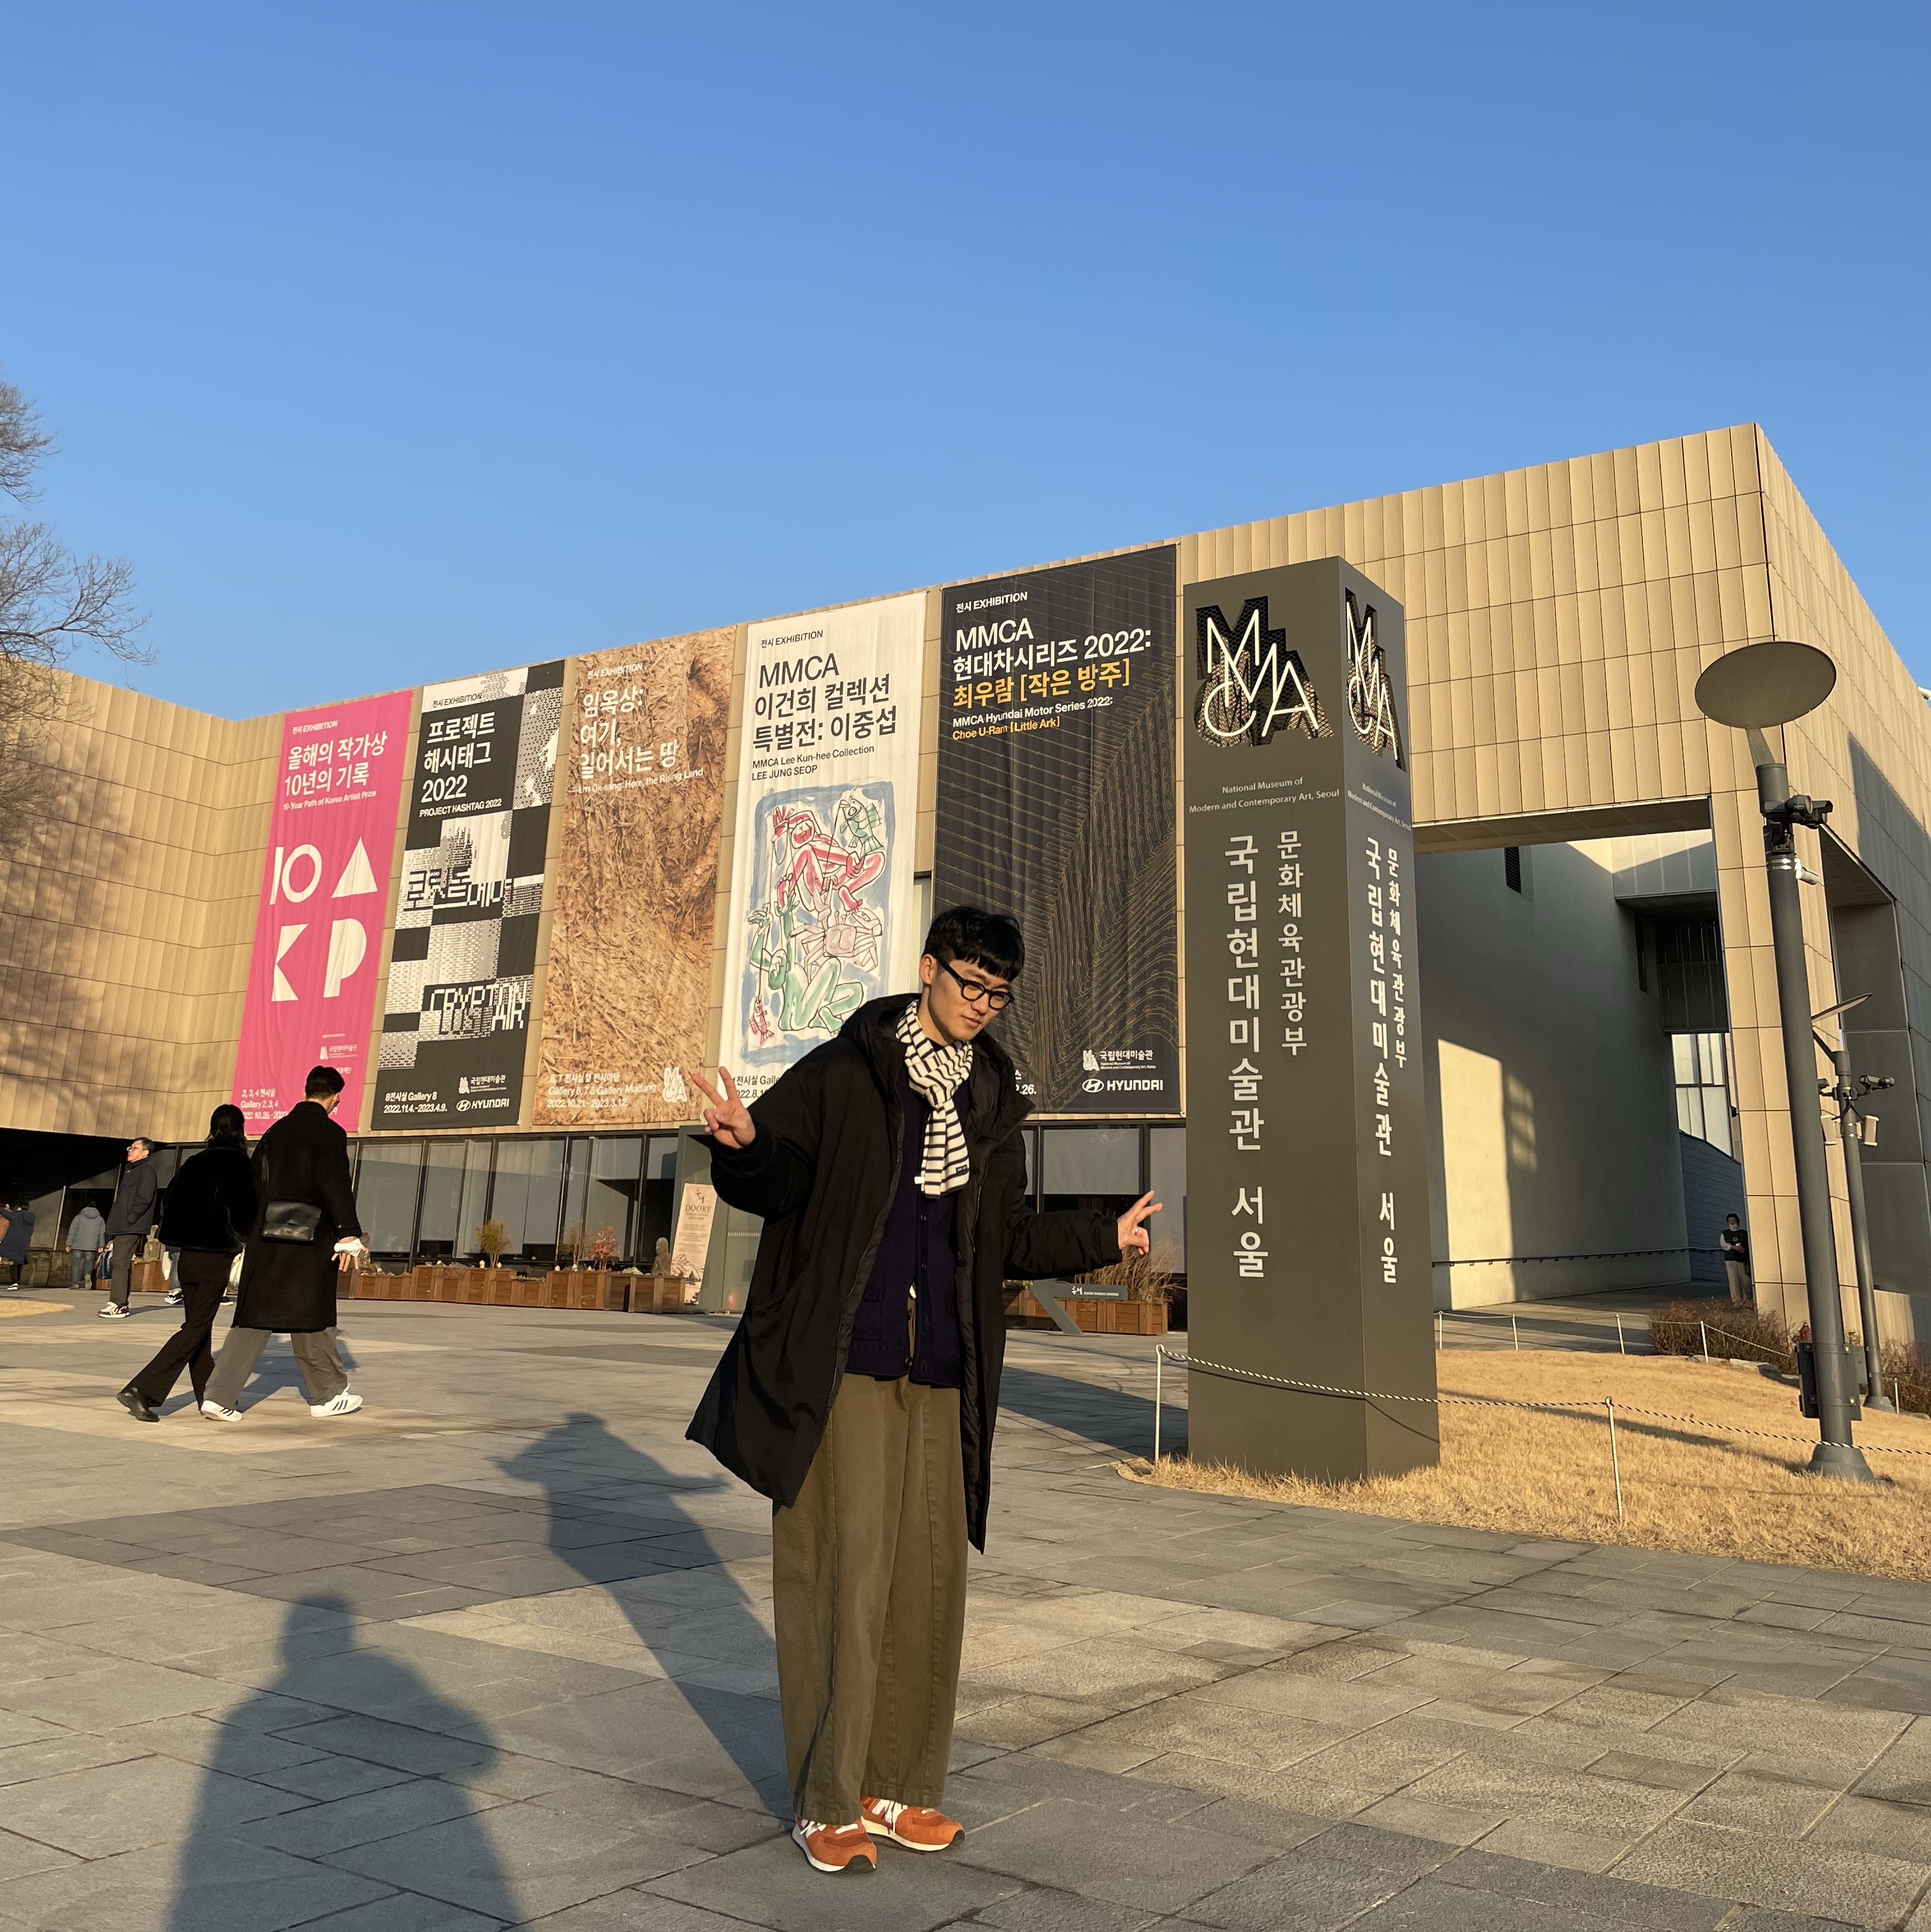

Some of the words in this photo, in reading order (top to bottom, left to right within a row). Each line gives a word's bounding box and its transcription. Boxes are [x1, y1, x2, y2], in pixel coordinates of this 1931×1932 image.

[956, 602, 972, 614] 전시
[973, 591, 1028, 611] EXHIBITION
[761, 639, 774, 648] 전시
[775, 630, 823, 646] EXHIBITION
[956, 618, 1034, 652] MMCA
[952, 639, 1078, 681] 현대차시리즈
[1084, 628, 1151, 660] 2022:
[600, 663, 643, 677] EXHIBITION
[759, 653, 839, 688] MMCA
[953, 676, 1014, 709] 최우람
[1020, 669, 1071, 703] [작은
[1078, 658, 1129, 692] 방주]
[444, 692, 483, 706] EXHIBITION
[583, 685, 644, 719] 임옥상:
[754, 686, 816, 720] 이건희
[824, 673, 890, 711] 컬렉션
[952, 715, 984, 727] MMCA
[986, 708, 1023, 724] Hyundai
[1025, 705, 1054, 719] Motor
[1055, 701, 1086, 713] Series
[1087, 696, 1113, 708] 2022:
[303, 720, 339, 733] EXHIBITION
[427, 711, 495, 744] 프로젝트
[580, 719, 622, 748] 여기,
[752, 718, 823, 752] 특별전:
[830, 705, 897, 742] 이중섭
[952, 729, 977, 740] Choe
[979, 724, 1008, 736] U-Ram
[1010, 719, 1038, 733] [Little
[1039, 716, 1060, 729] Ark]
[288, 740, 334, 770] 올해의
[337, 731, 388, 761] 작가상
[424, 742, 491, 773] 해시태그
[581, 747, 654, 779] 일어서는
[660, 738, 679, 768] 땅
[752, 759, 779, 769] MMCA
[781, 757, 795, 765] Lee
[797, 752, 831, 763] Kun-hee
[832, 745, 874, 758] Collection
[285, 768, 333, 796] 10년의
[336, 762, 369, 789] 기록
[625, 780, 645, 789] Here,
[645, 777, 659, 786] the
[659, 773, 682, 785] Rising
[683, 768, 704, 779] Land
[751, 771, 768, 781] LEE
[768, 768, 793, 779] JUNG
[793, 764, 818, 775] SEOP
[1222, 782, 1256, 794] National
[1257, 780, 1293, 790] Museum
[1294, 777, 1304, 785] of
[304, 799, 317, 807] Path
[317, 798, 324, 806] of
[324, 796, 342, 805] Korea
[343, 793, 360, 802] Artist
[362, 790, 376, 798] Prize
[420, 775, 468, 803] 2022
[1189, 804, 1220, 814] Modern
[1221, 800, 1237, 810] and
[1238, 795, 1297, 808] Contemporary
[1299, 792, 1314, 801] Art,
[1316, 788, 1340, 799] Seoul
[419, 805, 452, 818] PROJECT
[452, 801, 485, 813] HASHTAG
[485, 798, 502, 807] 2022
[1277, 830, 1307, 1056] 문화체육관광부
[1387, 848, 1407, 1068] 문화체육관광부
[1224, 835, 1264, 1150] 국립현대미술관
[1099, 1050, 1153, 1061] 국립현대미술관
[1366, 837, 1393, 1157] 국립현대미술관
[1380, 1192, 1398, 1284] 서울
[408, 1092, 432, 1102] Gallery
[432, 1091, 438, 1100] 8
[549, 1086, 575, 1098] Gallery
[597, 1086, 624, 1097] Gallery
[625, 1083, 657, 1095] Madang
[1106, 1079, 1163, 1091] HYUNDAI
[471, 1098, 510, 1109] HYUNDAI
[685, 1204, 712, 1213] DOORE
[1231, 1186, 1269, 1277] 서울
